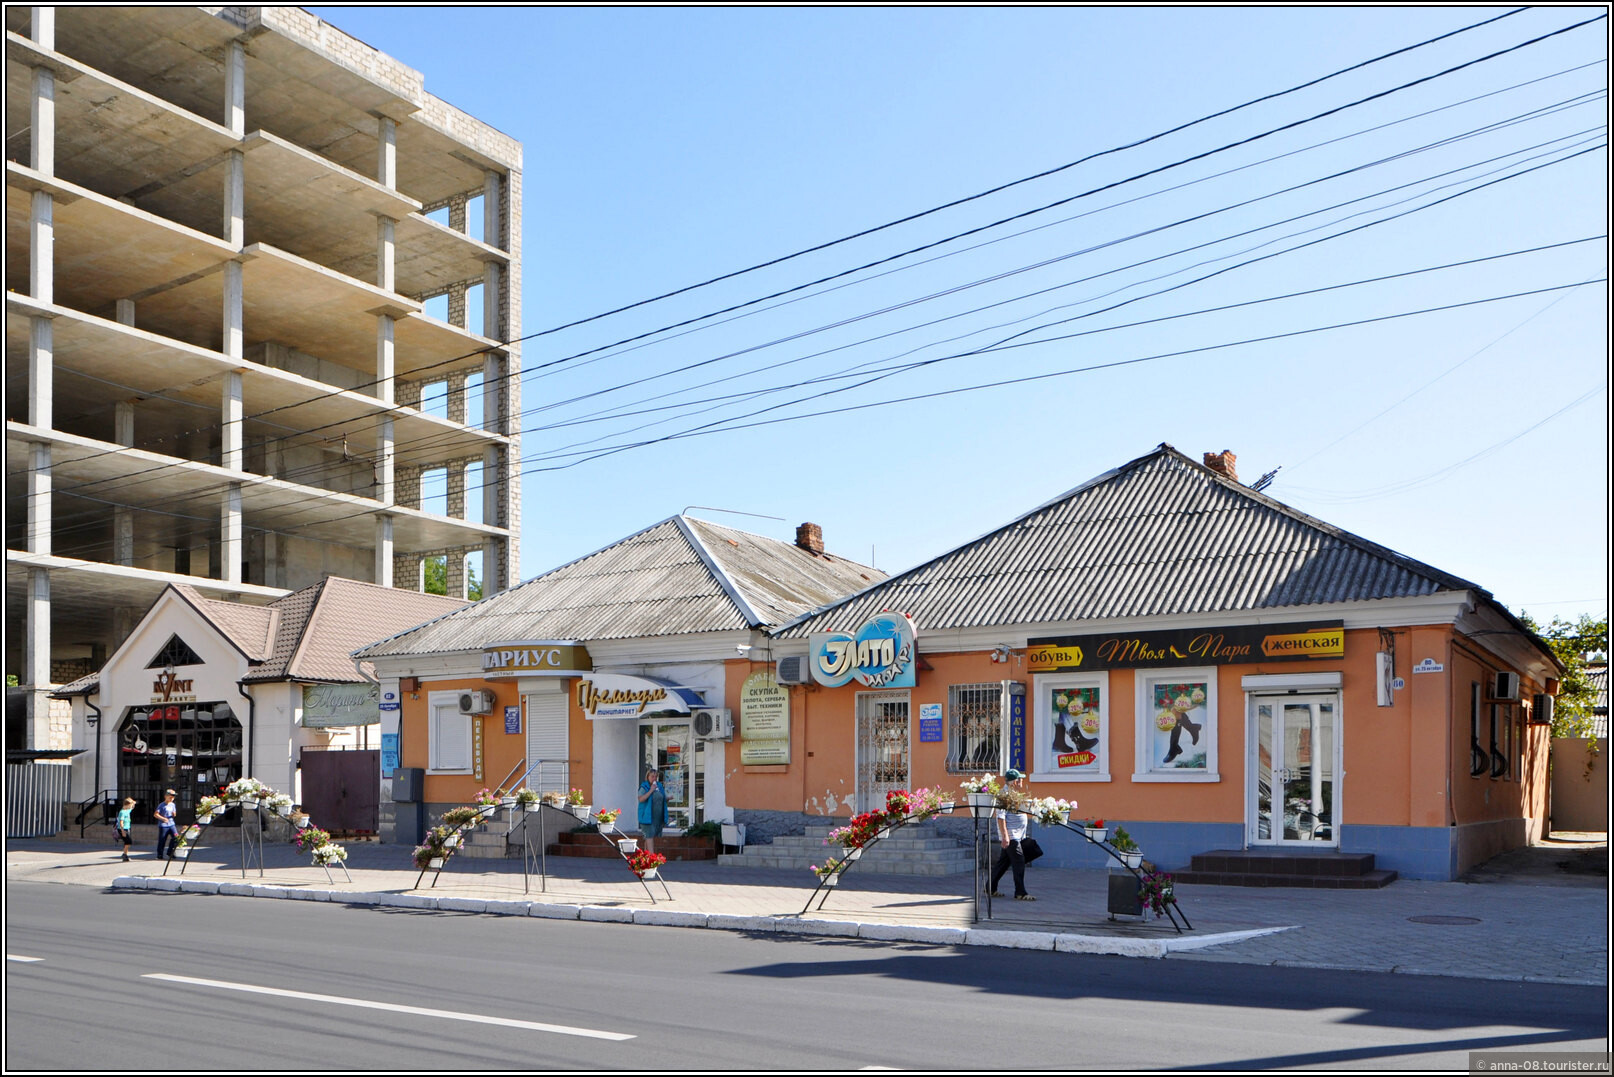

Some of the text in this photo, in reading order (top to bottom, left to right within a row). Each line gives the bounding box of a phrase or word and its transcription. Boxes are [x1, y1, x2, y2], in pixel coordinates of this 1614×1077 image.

[1030, 633, 1340, 665] обувь Твоя Пара женская
[481, 649, 561, 669] ТАРИУС
[819, 638, 895, 678] ЗЛАТО
[576, 680, 667, 714] Премиум
[749, 687, 779, 696] СКУПКА
[1177, 700, 1190, 709] 20%
[1084, 718, 1099, 728] 30%
[1159, 717, 1175, 726] 30%
[1013, 696, 1022, 769] ЛОМБАРД
[1059, 754, 1090, 765] СКИДКИ
